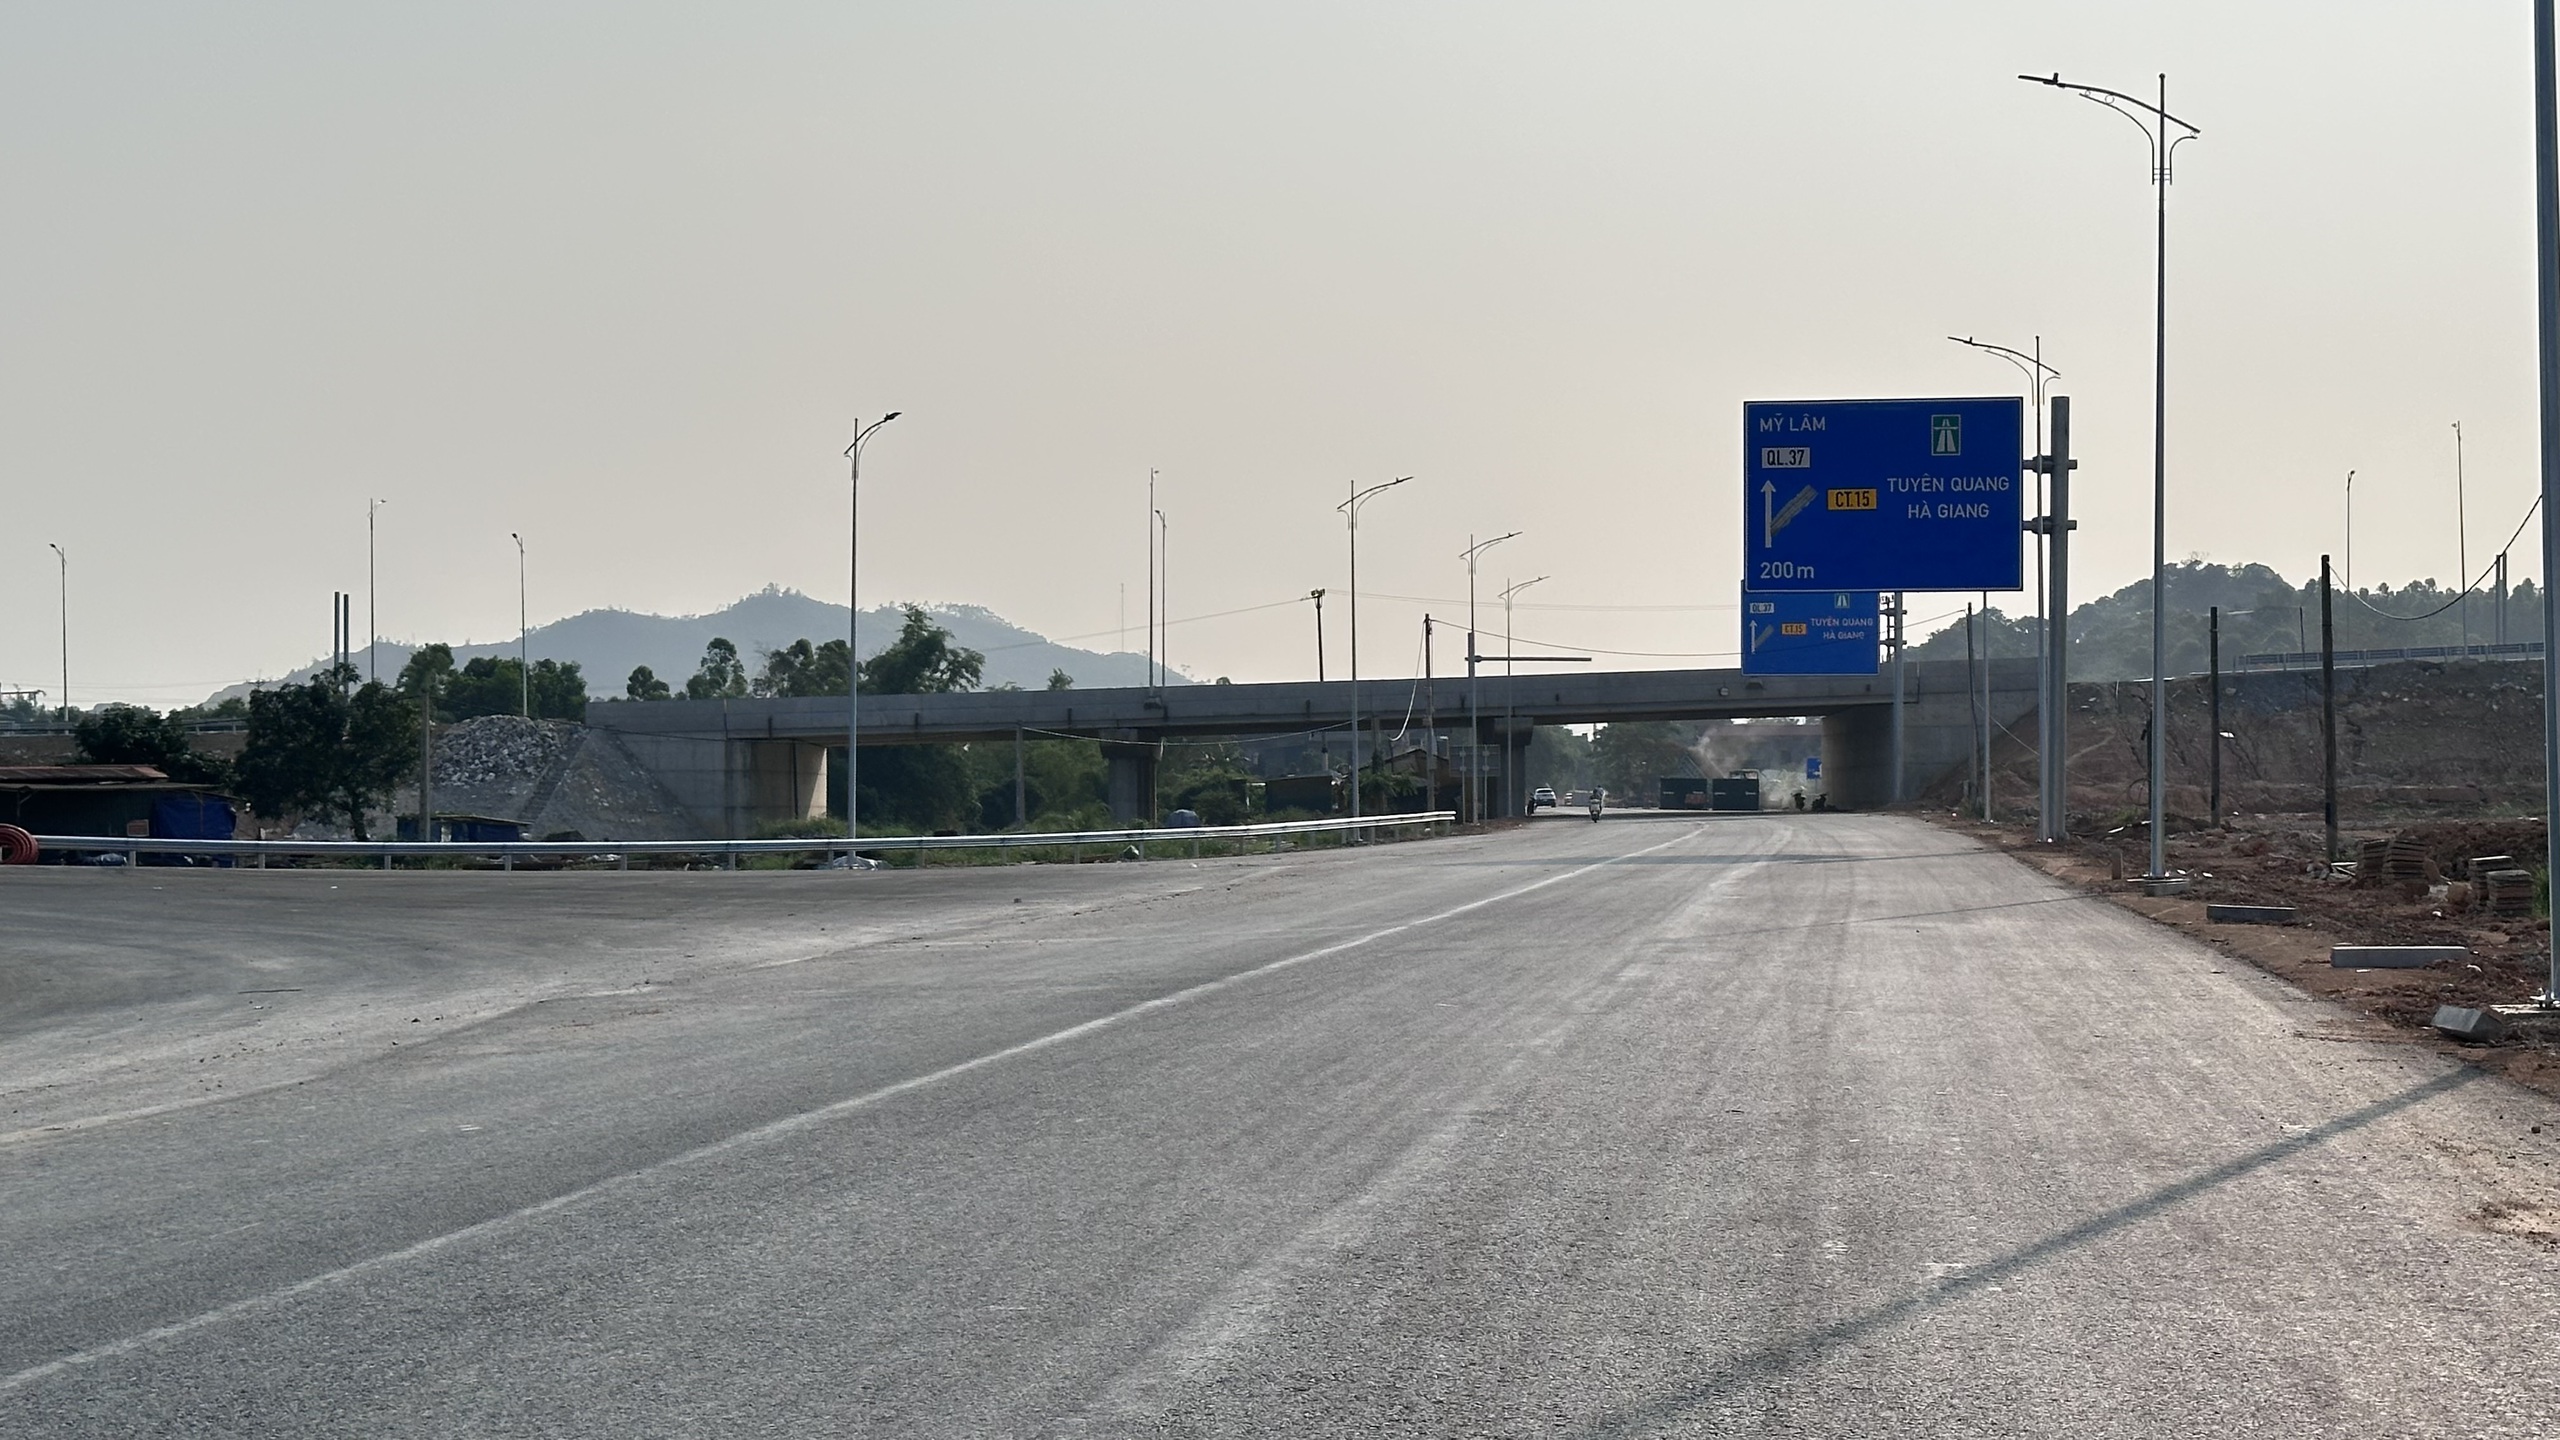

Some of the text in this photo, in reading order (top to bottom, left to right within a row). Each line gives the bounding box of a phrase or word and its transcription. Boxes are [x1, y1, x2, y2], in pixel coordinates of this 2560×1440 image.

[1760, 412, 1826, 433] MỸ LÂM
[1767, 449, 1805, 466] QL.37
[1887, 473, 2010, 493] TUYÊN QUANG
[1835, 490, 1870, 508] CT.15
[1908, 500, 1990, 519] HÀ GIANG
[1760, 562, 1815, 579] 200 m
[1842, 618, 1874, 627] QUANG
